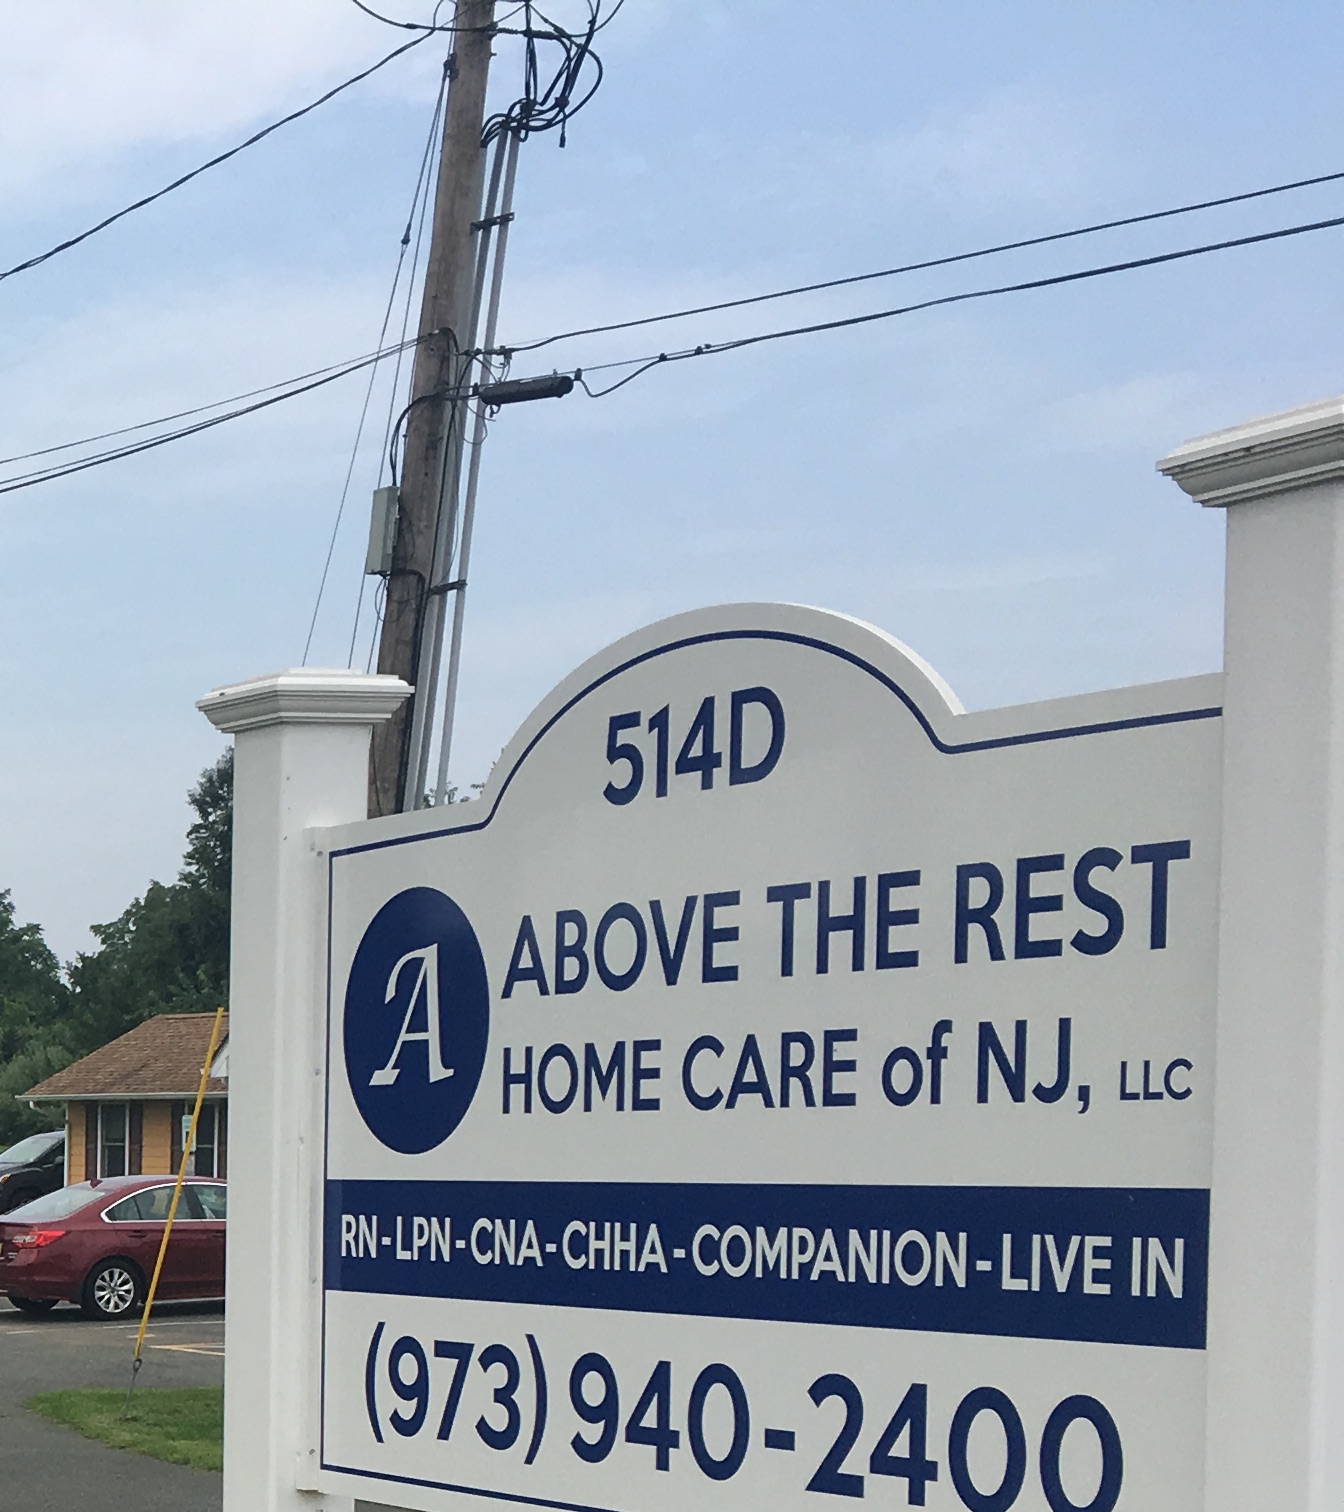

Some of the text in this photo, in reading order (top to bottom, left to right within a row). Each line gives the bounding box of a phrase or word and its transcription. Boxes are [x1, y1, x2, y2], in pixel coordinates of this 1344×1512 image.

[601, 685, 787, 807] 514D
[500, 839, 1193, 1000] ABOVE THE REST
[368, 942, 455, 1087] A
[502, 1017, 1193, 1114] HOME CARE of NJ, LLC
[1131, 1236, 1185, 1299] IN
[366, 1321, 548, 1466] (973)
